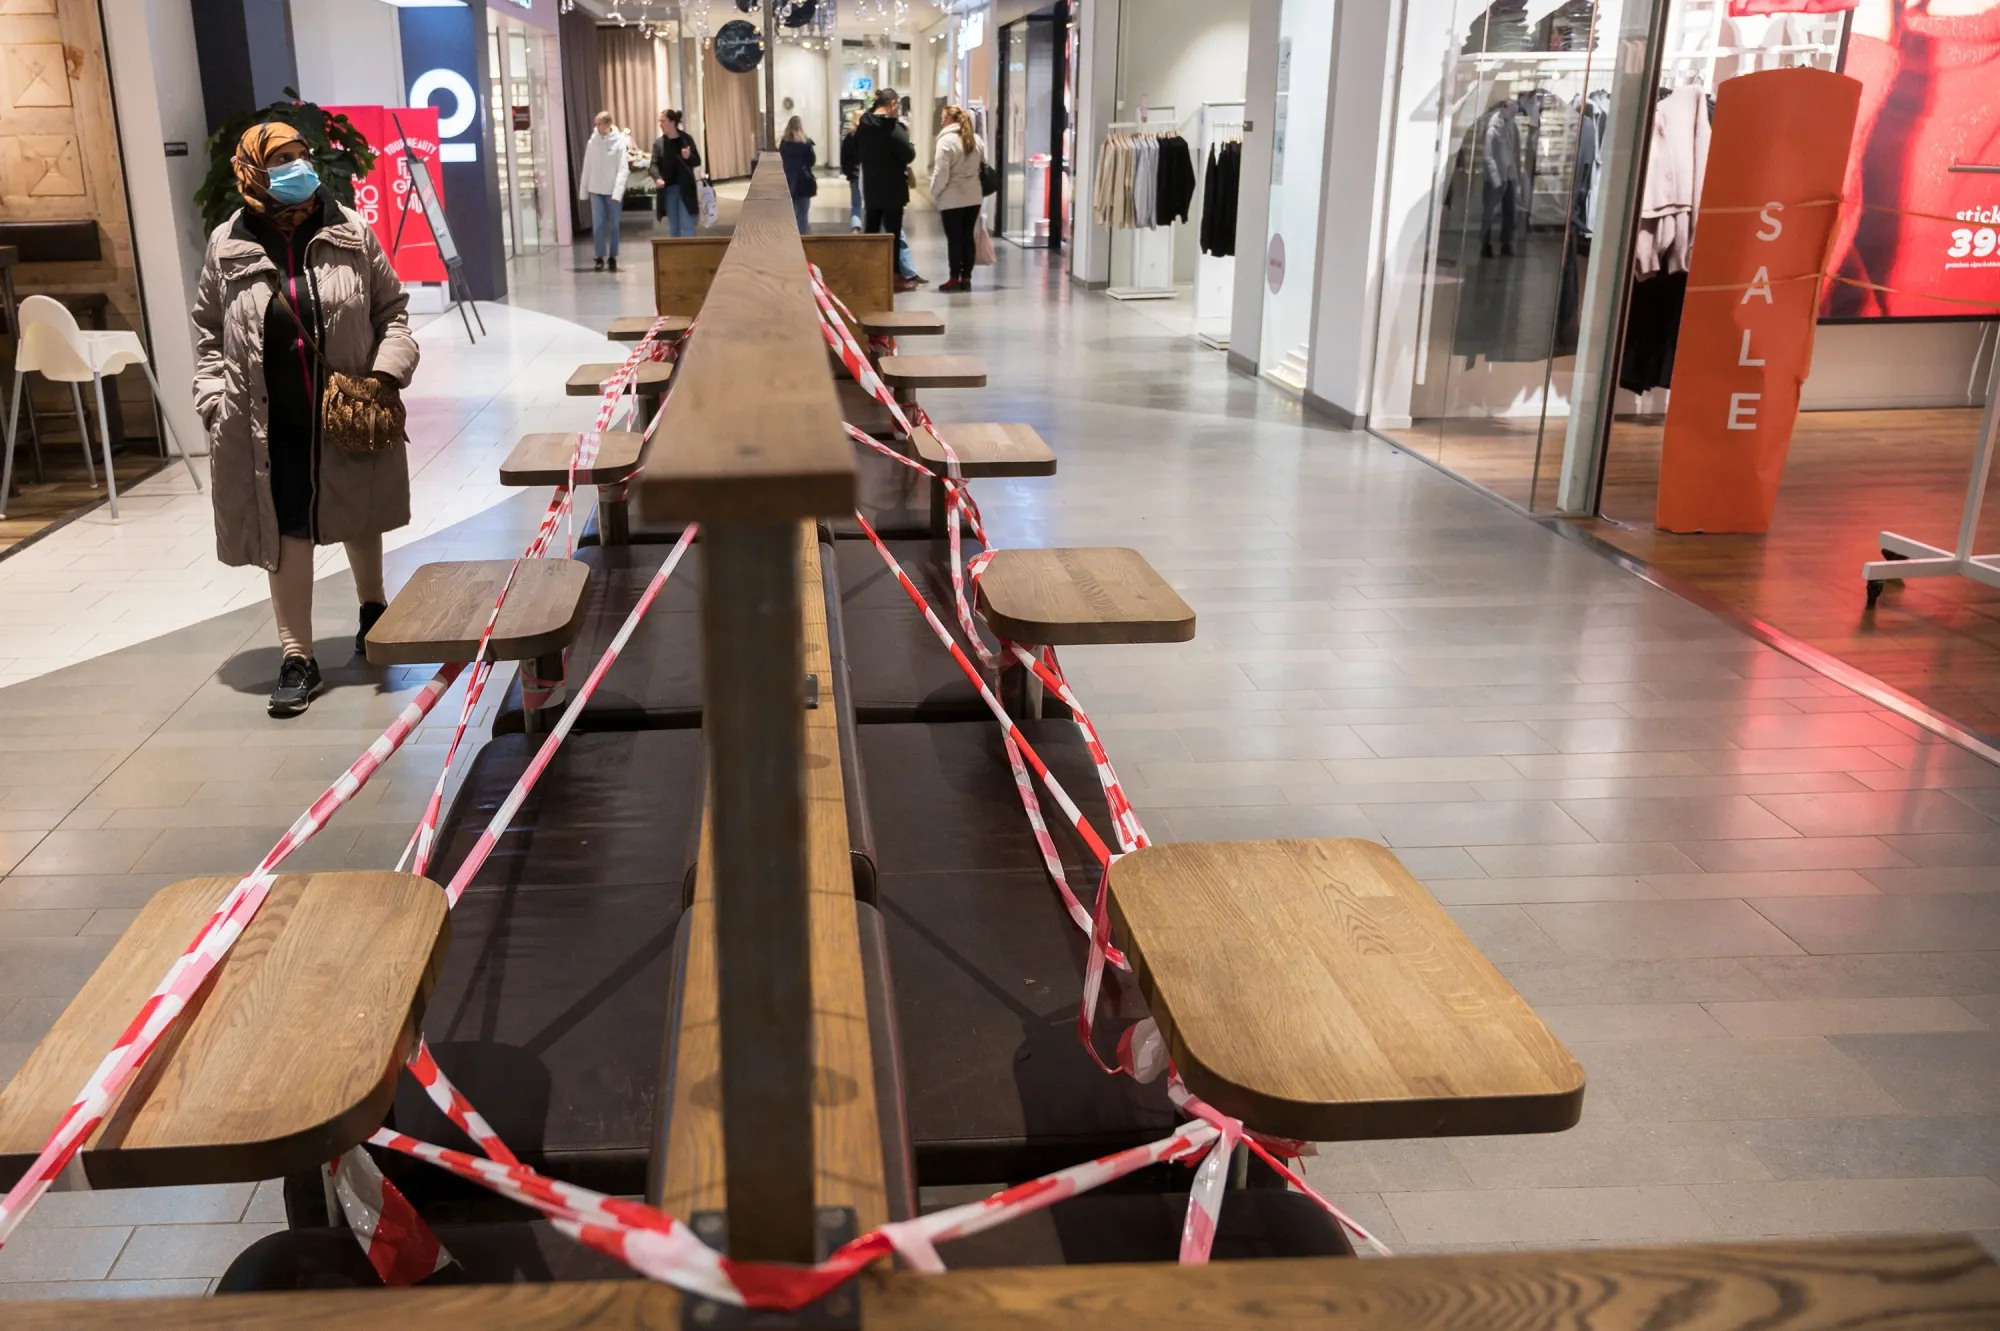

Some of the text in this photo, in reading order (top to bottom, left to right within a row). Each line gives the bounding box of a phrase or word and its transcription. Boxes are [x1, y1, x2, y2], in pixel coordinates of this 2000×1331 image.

[406, 138, 438, 155] BEAUTY
[1947, 228, 2000, 258] 39
[1727, 202, 1784, 430] SALE
